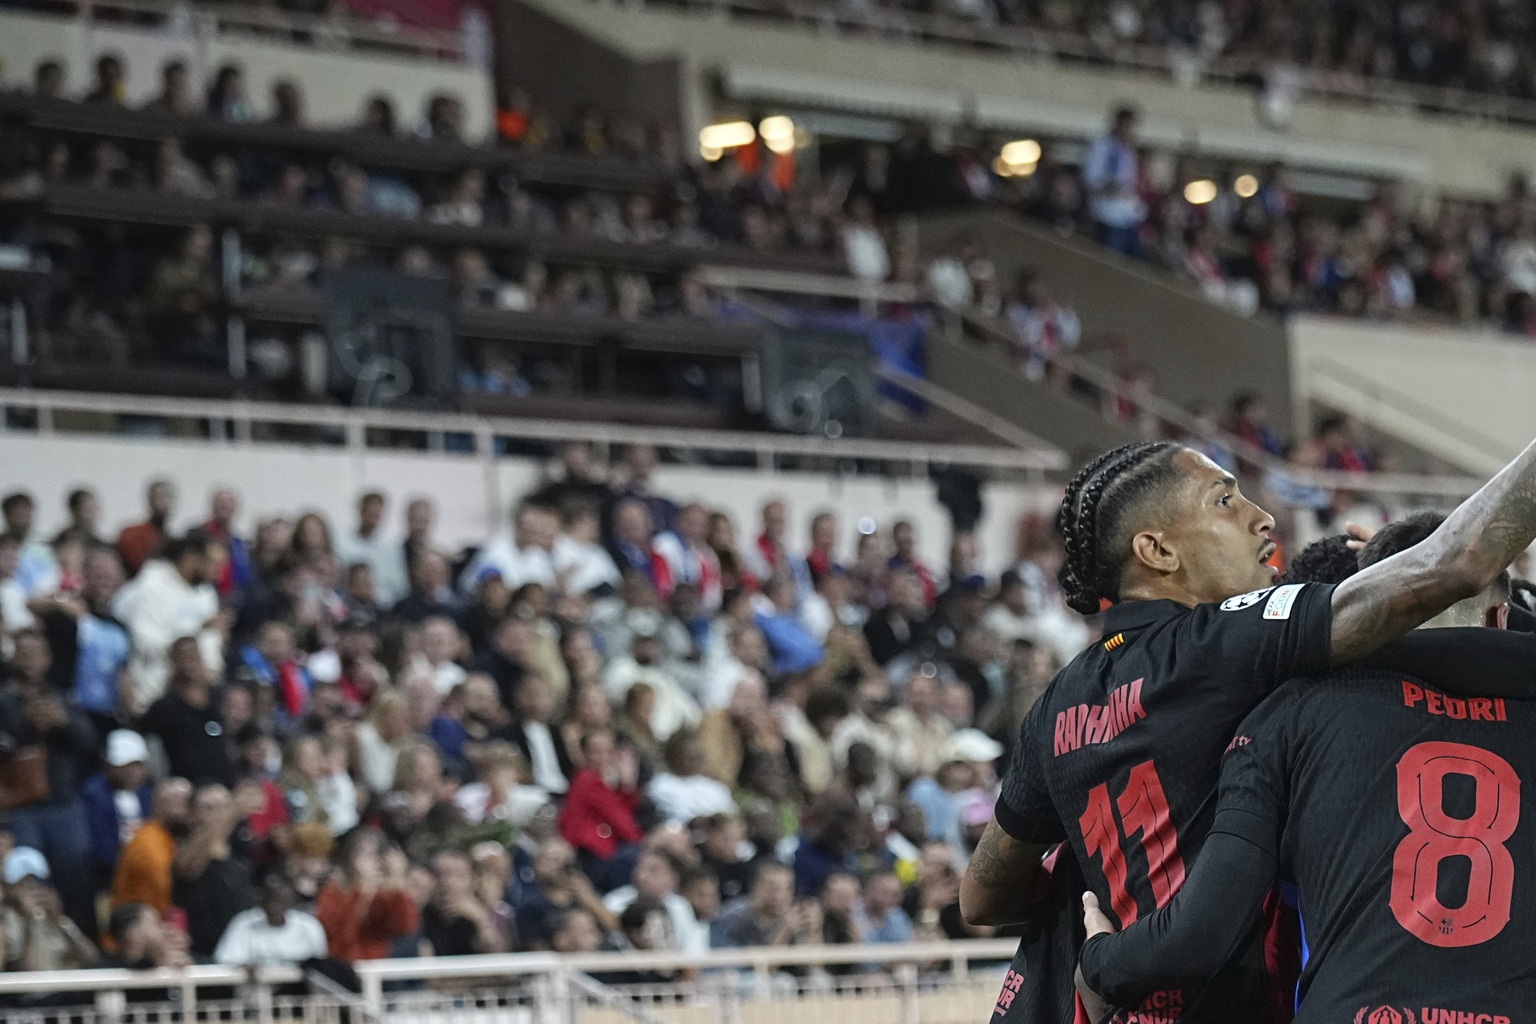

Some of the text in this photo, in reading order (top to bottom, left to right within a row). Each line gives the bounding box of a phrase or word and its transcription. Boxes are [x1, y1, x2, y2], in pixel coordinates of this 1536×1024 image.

[1402, 681, 1507, 721] PEDRI
[1079, 759, 1187, 931] 11
[1388, 740, 1522, 948] 8
